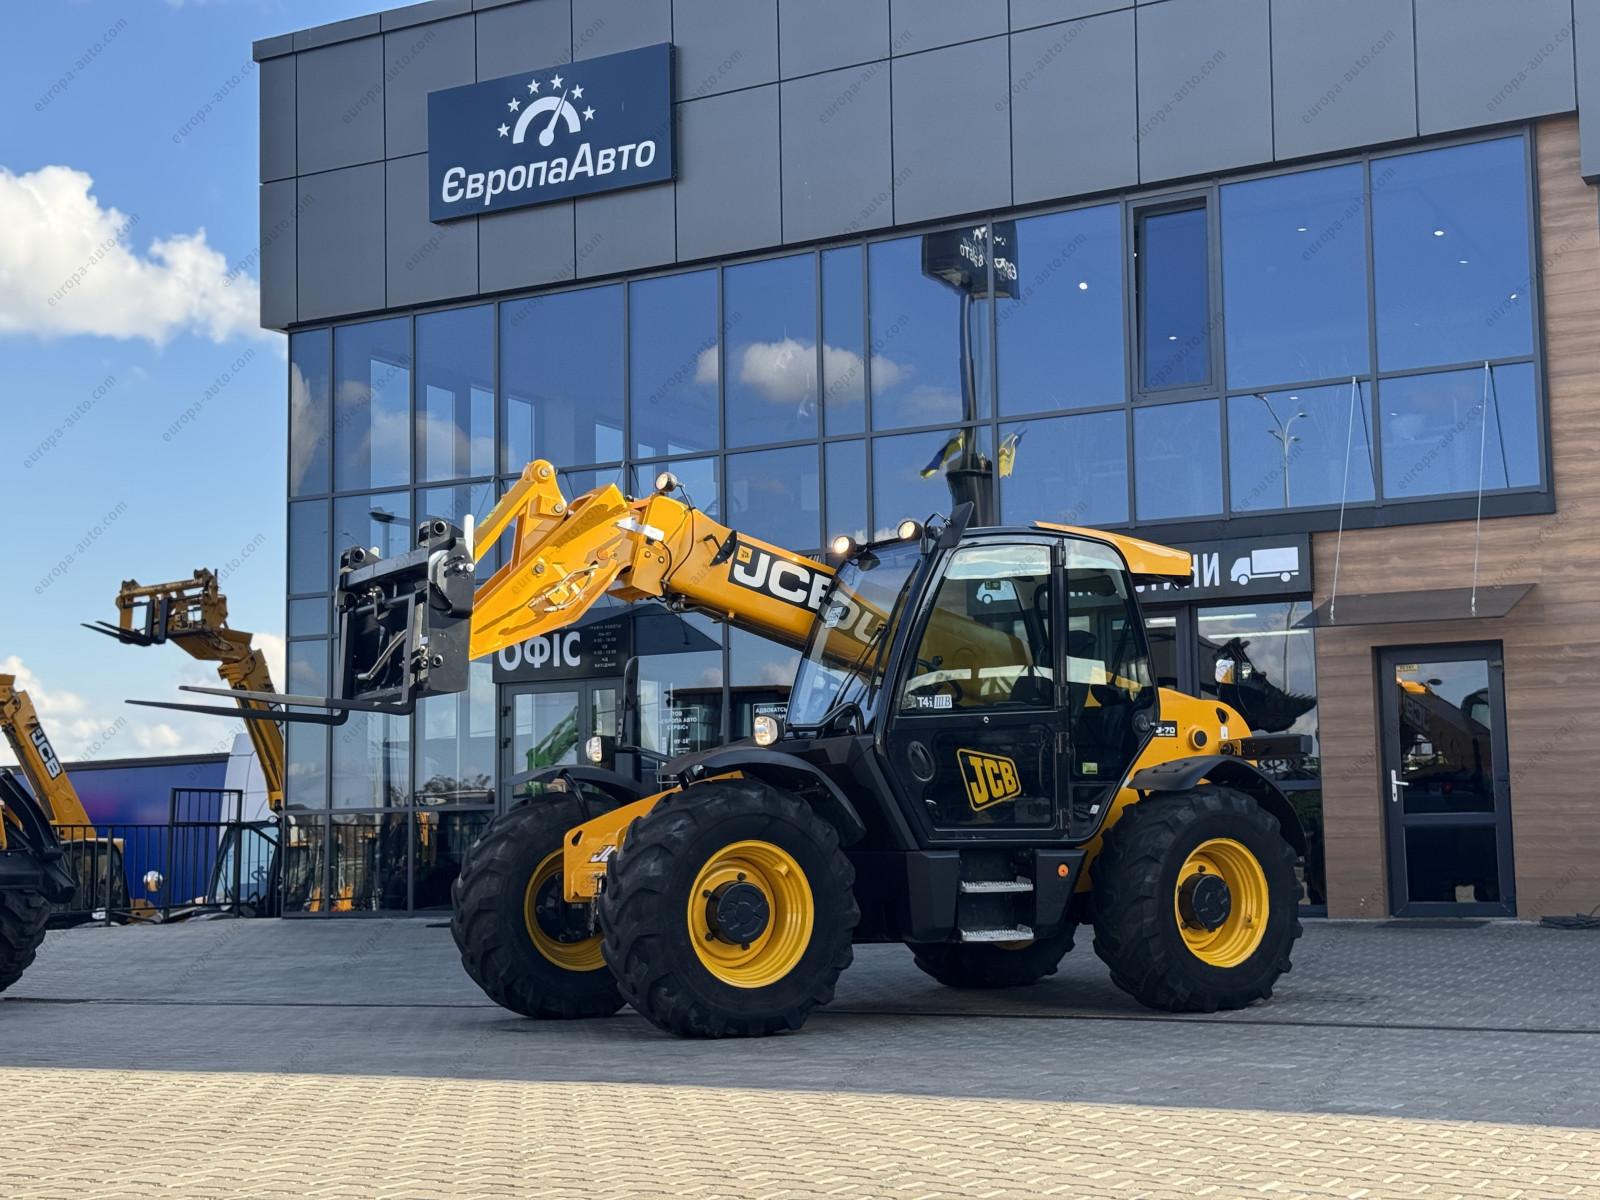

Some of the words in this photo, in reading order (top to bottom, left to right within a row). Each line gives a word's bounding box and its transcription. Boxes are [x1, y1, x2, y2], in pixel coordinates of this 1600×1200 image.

[442, 139, 656, 206] ЄвропаАвто
[498, 631, 581, 672] ОФІС
[31, 731, 61, 778] JCB
[968, 755, 1017, 804] JCB
